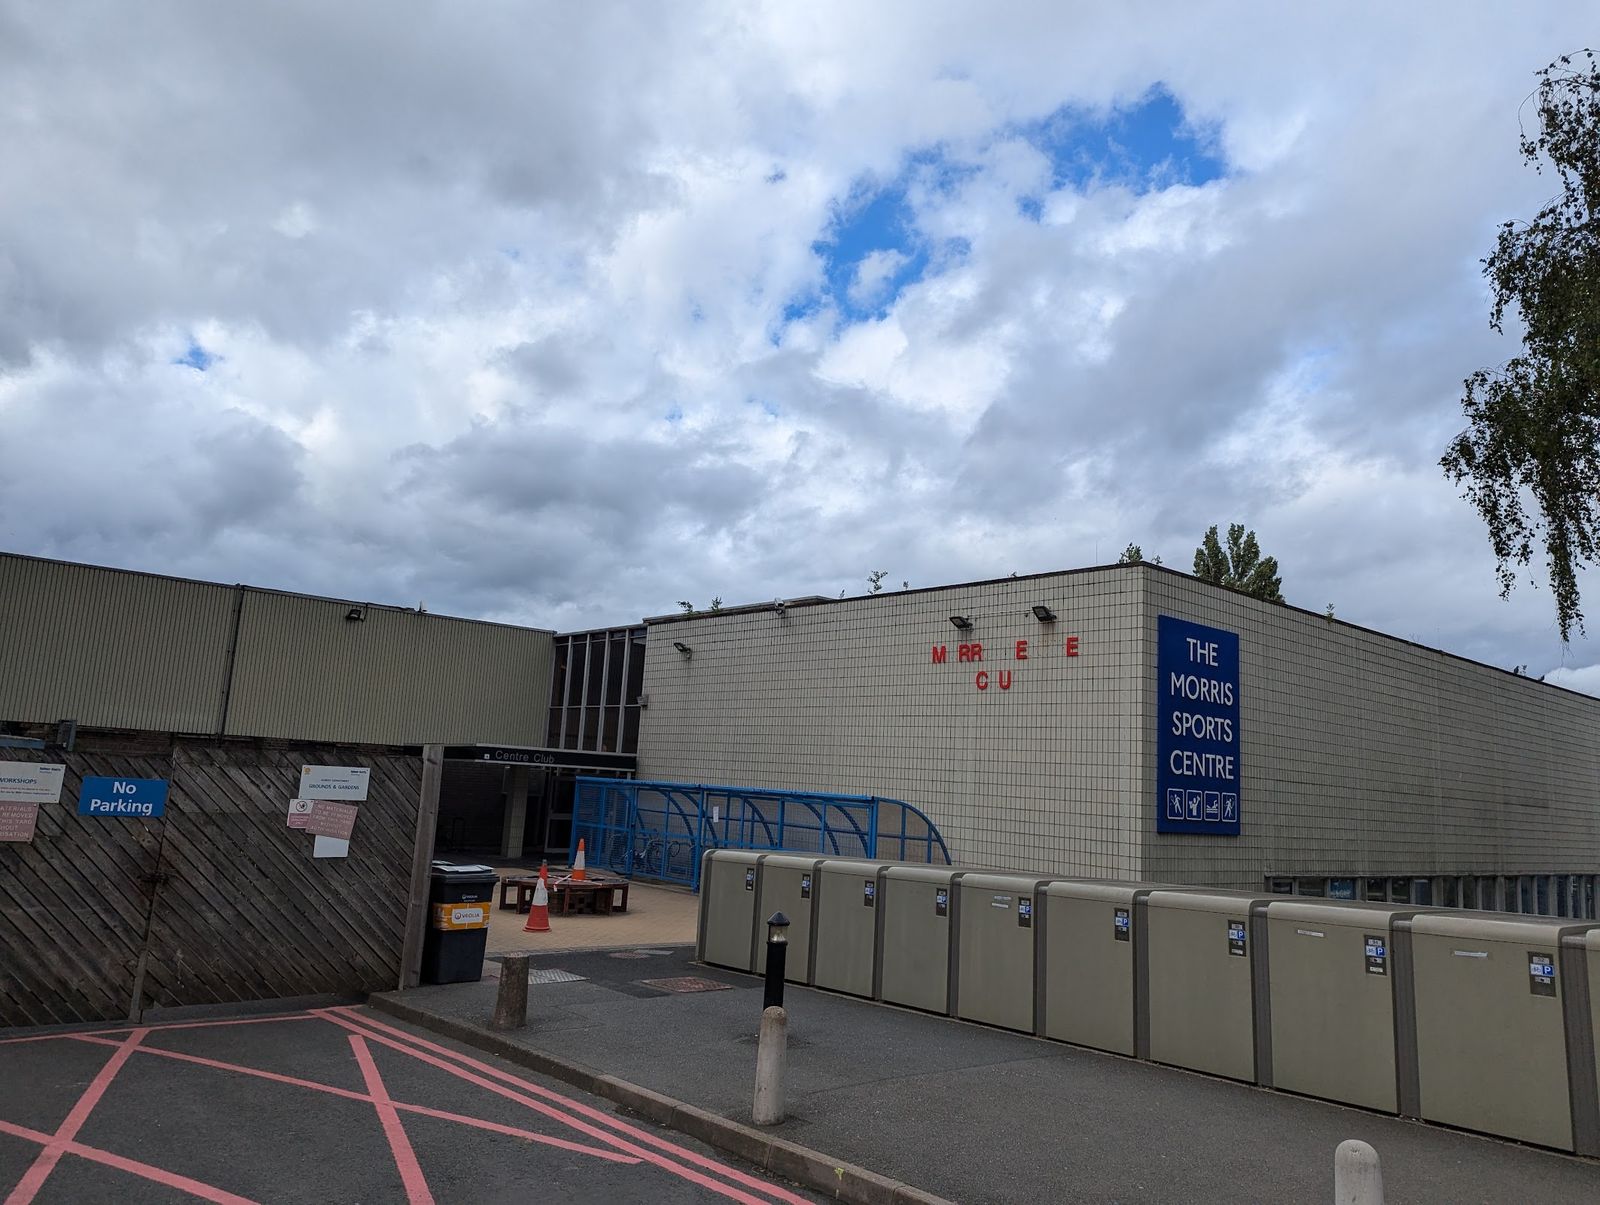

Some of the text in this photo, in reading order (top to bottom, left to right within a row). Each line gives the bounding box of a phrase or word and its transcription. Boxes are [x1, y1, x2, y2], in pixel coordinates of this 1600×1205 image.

[1186, 637, 1218, 667] THE
[1170, 671, 1234, 706] MORRIS
[1172, 711, 1233, 743] SPORTS
[495, 750, 555, 764] Centre Club
[1170, 750, 1234, 780] CENTRE
[113, 781, 137, 795] No
[90, 799, 153, 816] Parking
[1377, 947, 1384, 956] P
[1544, 966, 1552, 974] P
